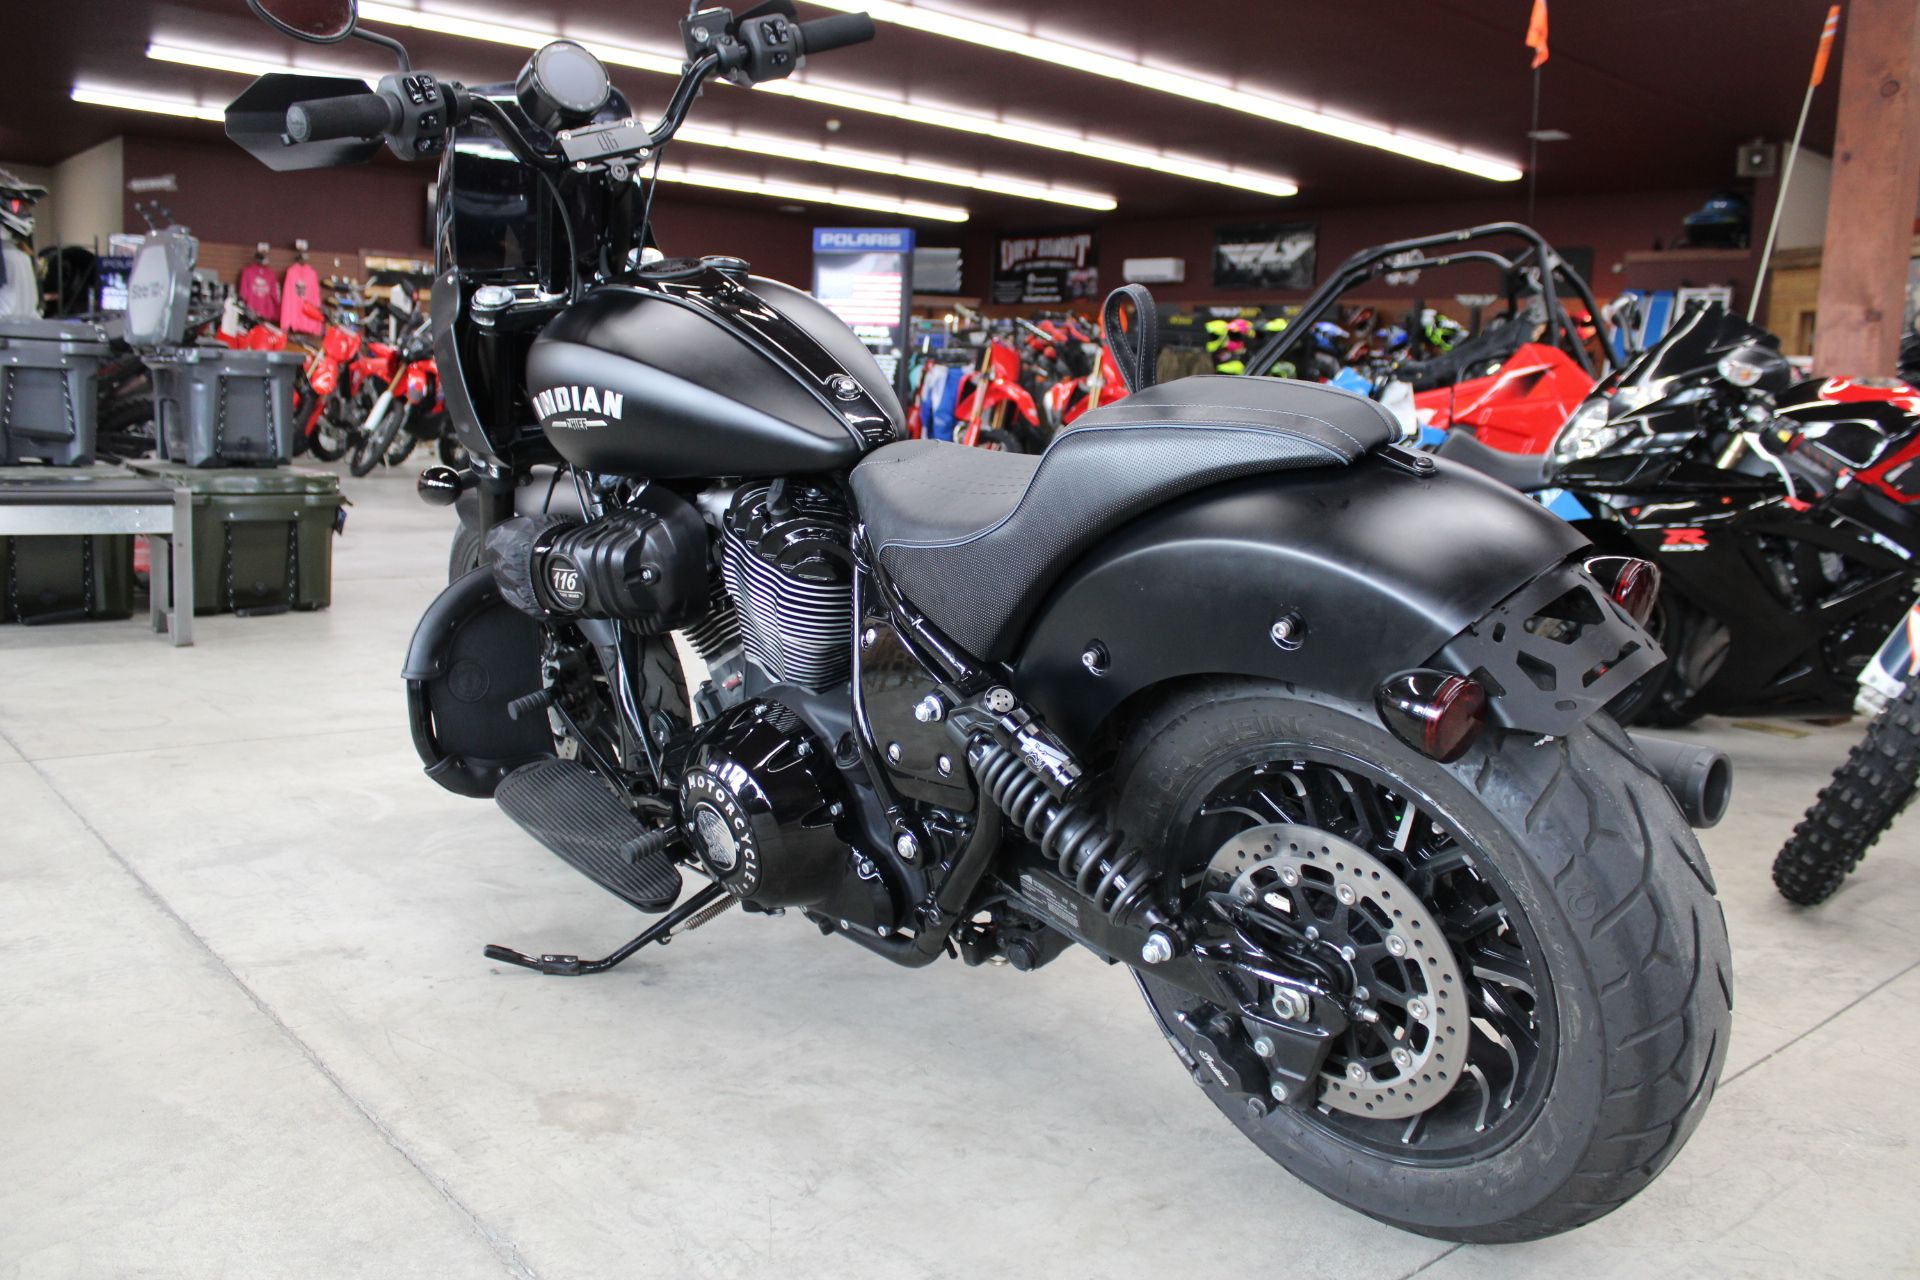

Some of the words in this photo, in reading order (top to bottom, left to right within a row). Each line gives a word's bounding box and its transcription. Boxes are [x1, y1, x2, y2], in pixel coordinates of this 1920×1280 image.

[821, 233, 901, 247] POLARIS
[533, 386, 623, 420] INDIAN
[553, 571, 578, 591] 116
[687, 775, 757, 883] MOTORCYCLE
